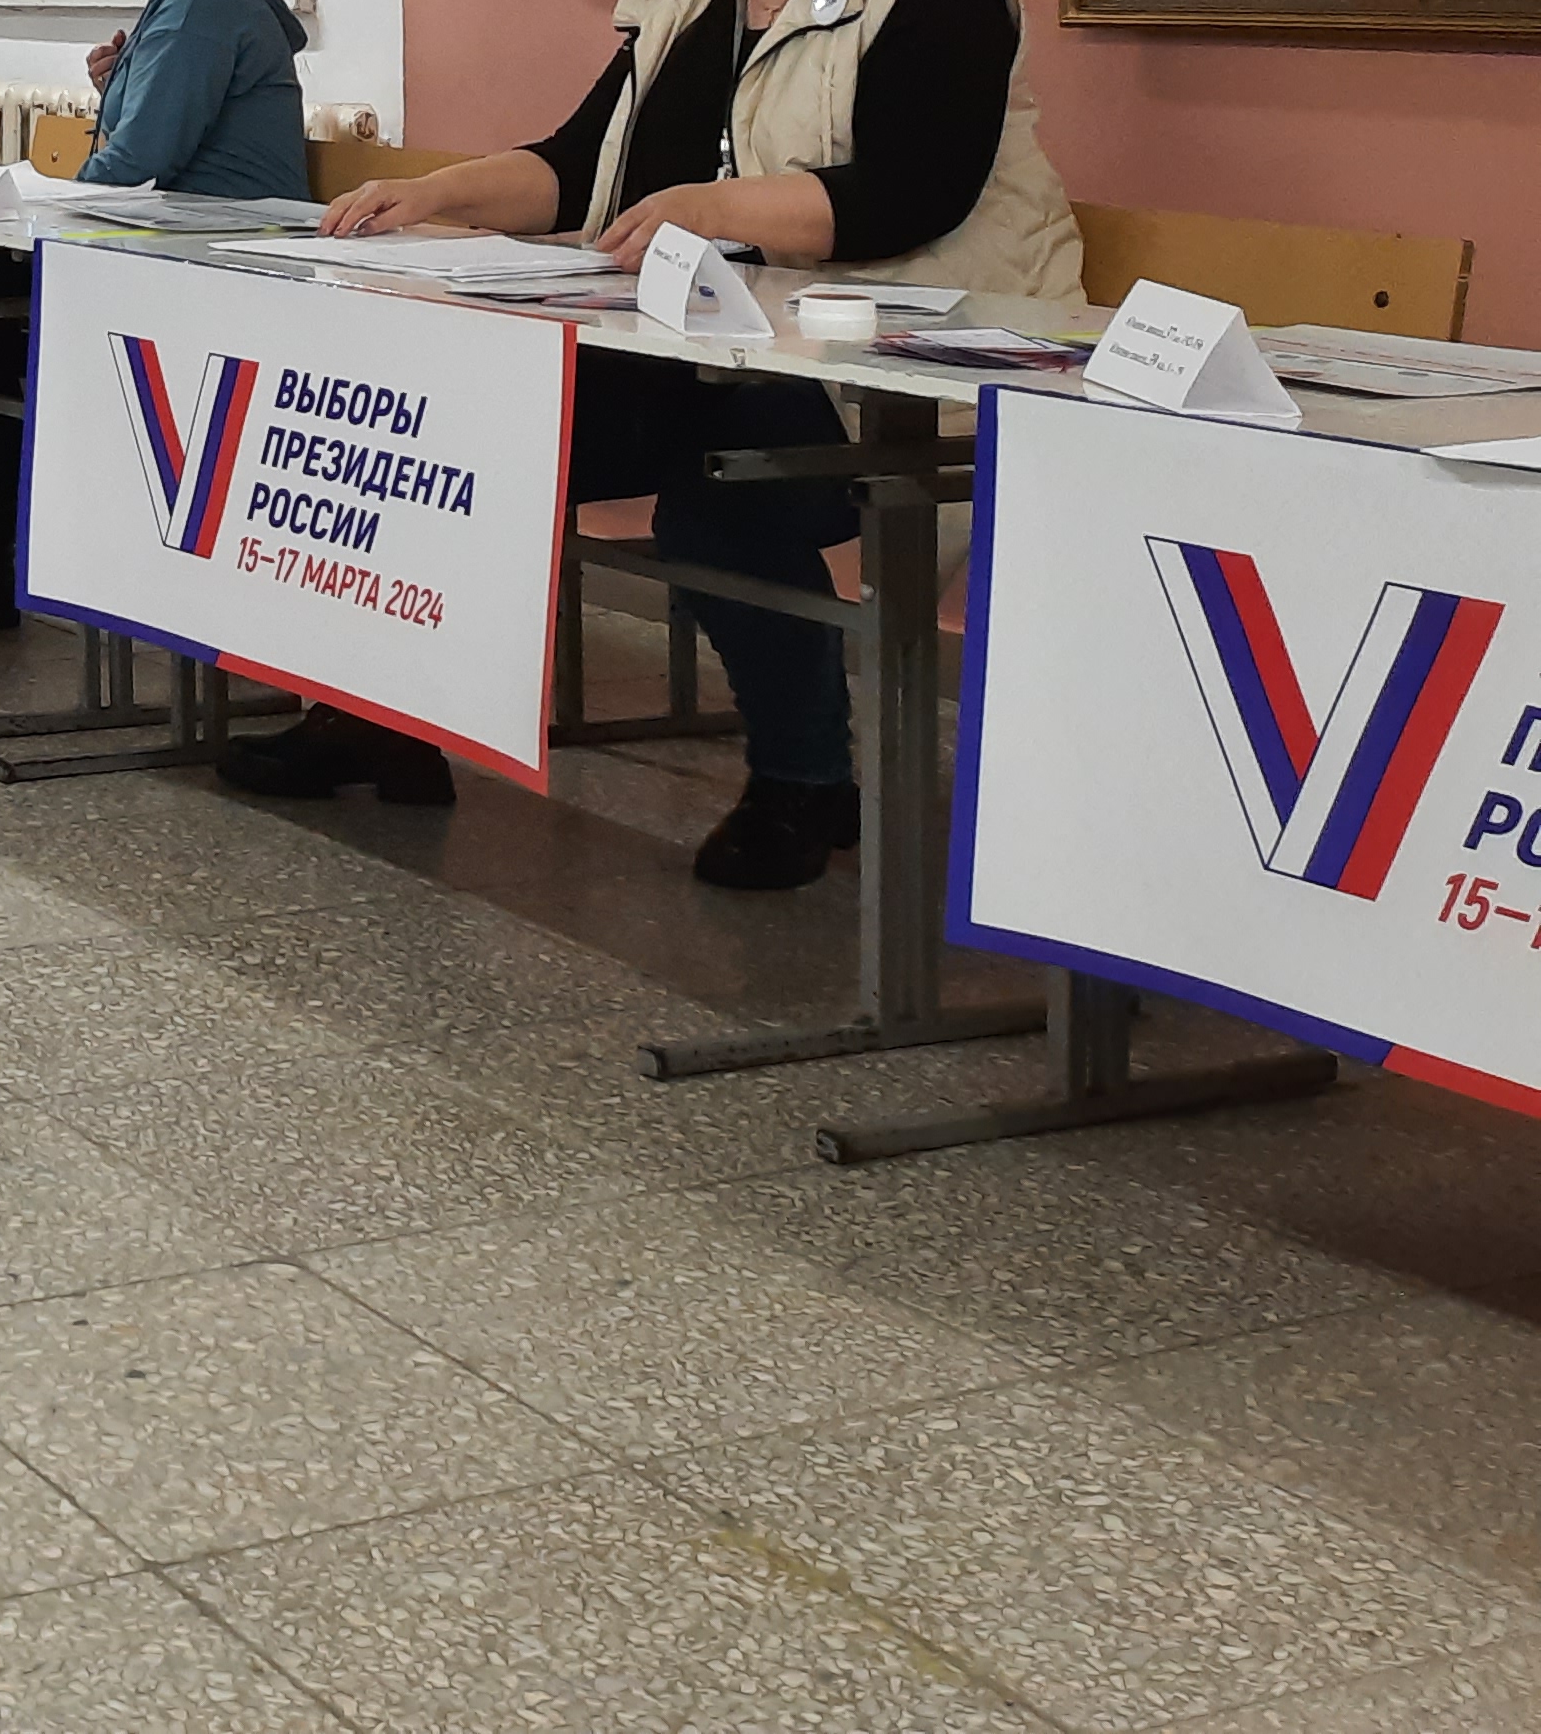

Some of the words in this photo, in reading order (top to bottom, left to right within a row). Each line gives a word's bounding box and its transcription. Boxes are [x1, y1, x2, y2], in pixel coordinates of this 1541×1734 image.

[274, 368, 428, 438] ВЫБОРЫ
[260, 426, 475, 516] ПРЕЗИДЕНТА
[247, 482, 381, 554] РОССИИ
[300, 554, 380, 611] МАРТА
[384, 580, 445, 630] 2024
